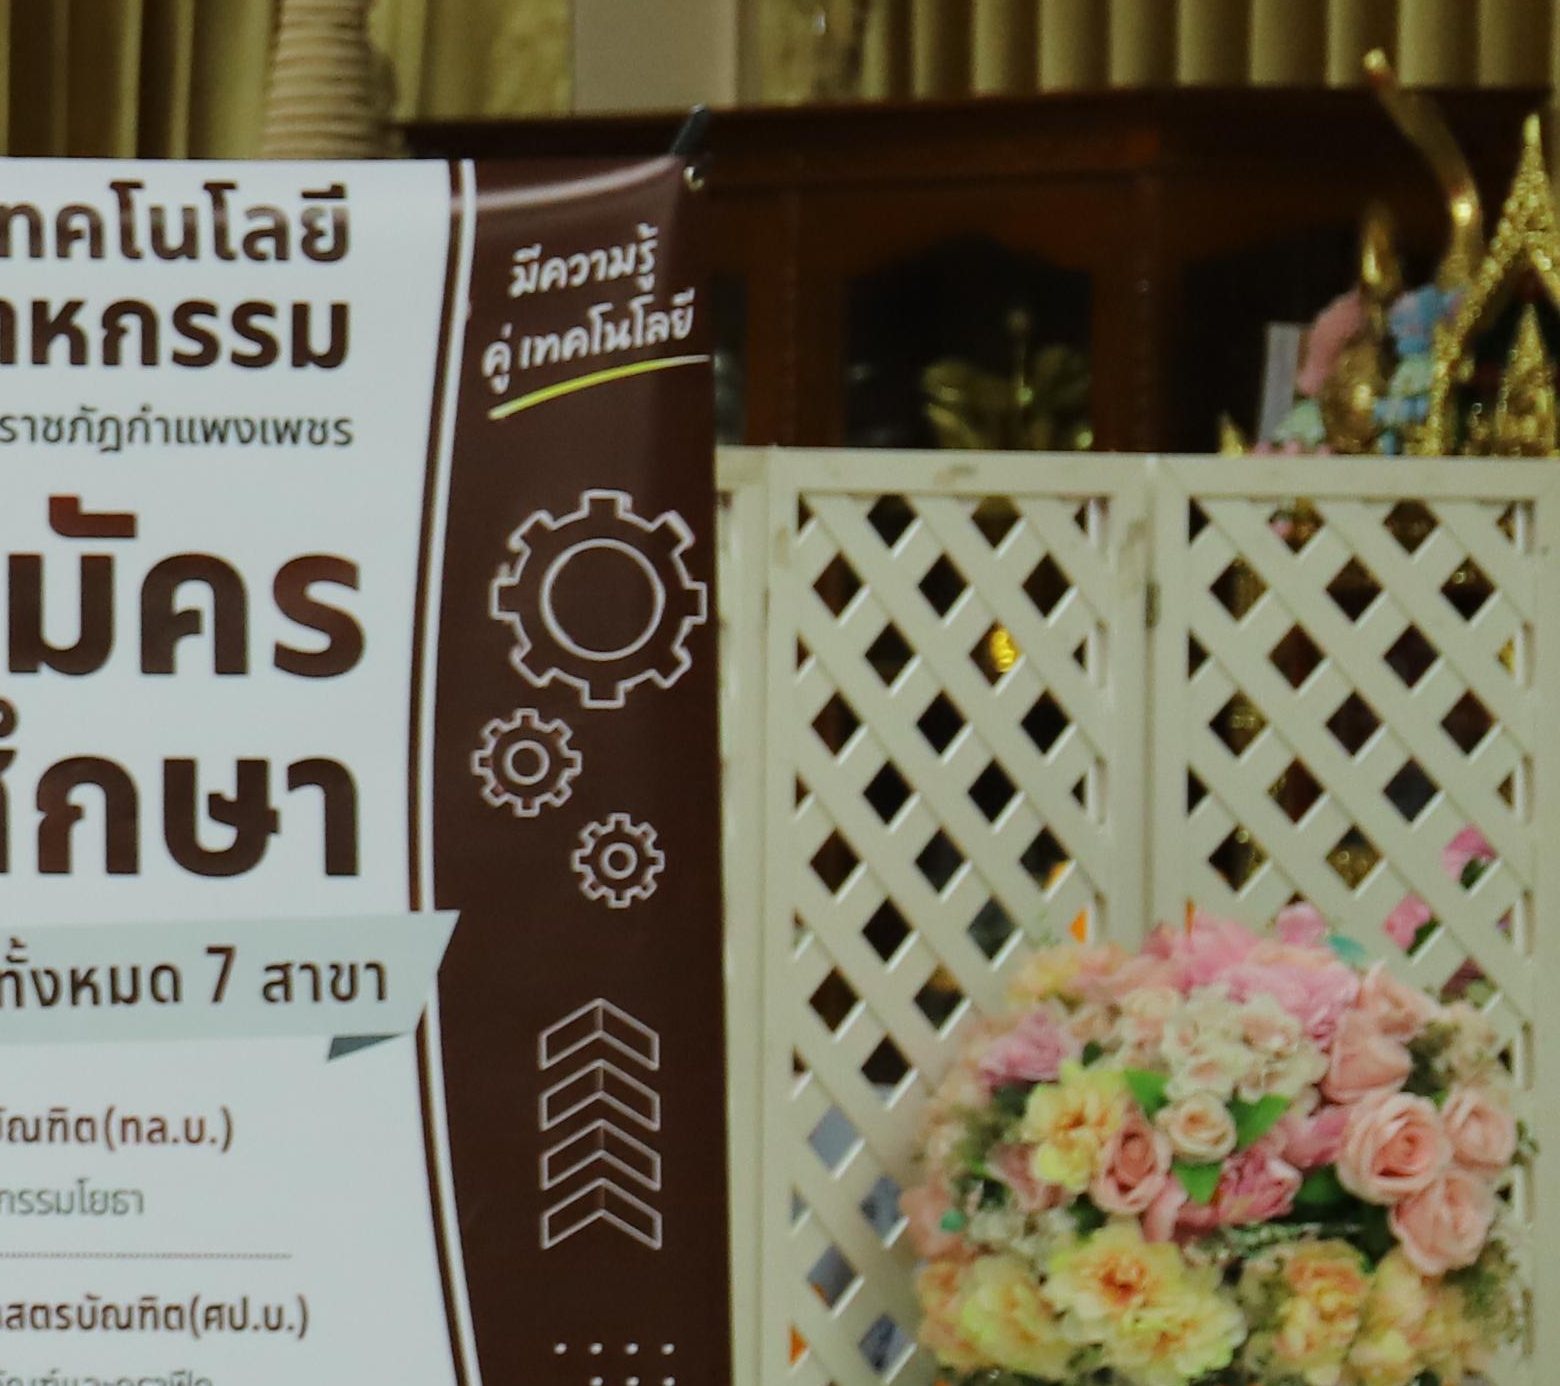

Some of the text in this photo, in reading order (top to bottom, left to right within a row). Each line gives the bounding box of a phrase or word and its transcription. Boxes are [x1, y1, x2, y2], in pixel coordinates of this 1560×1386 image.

[508, 221, 659, 298] มีความรู้
[205, 945, 236, 1004] 7
[261, 961, 387, 1004] สาขา
